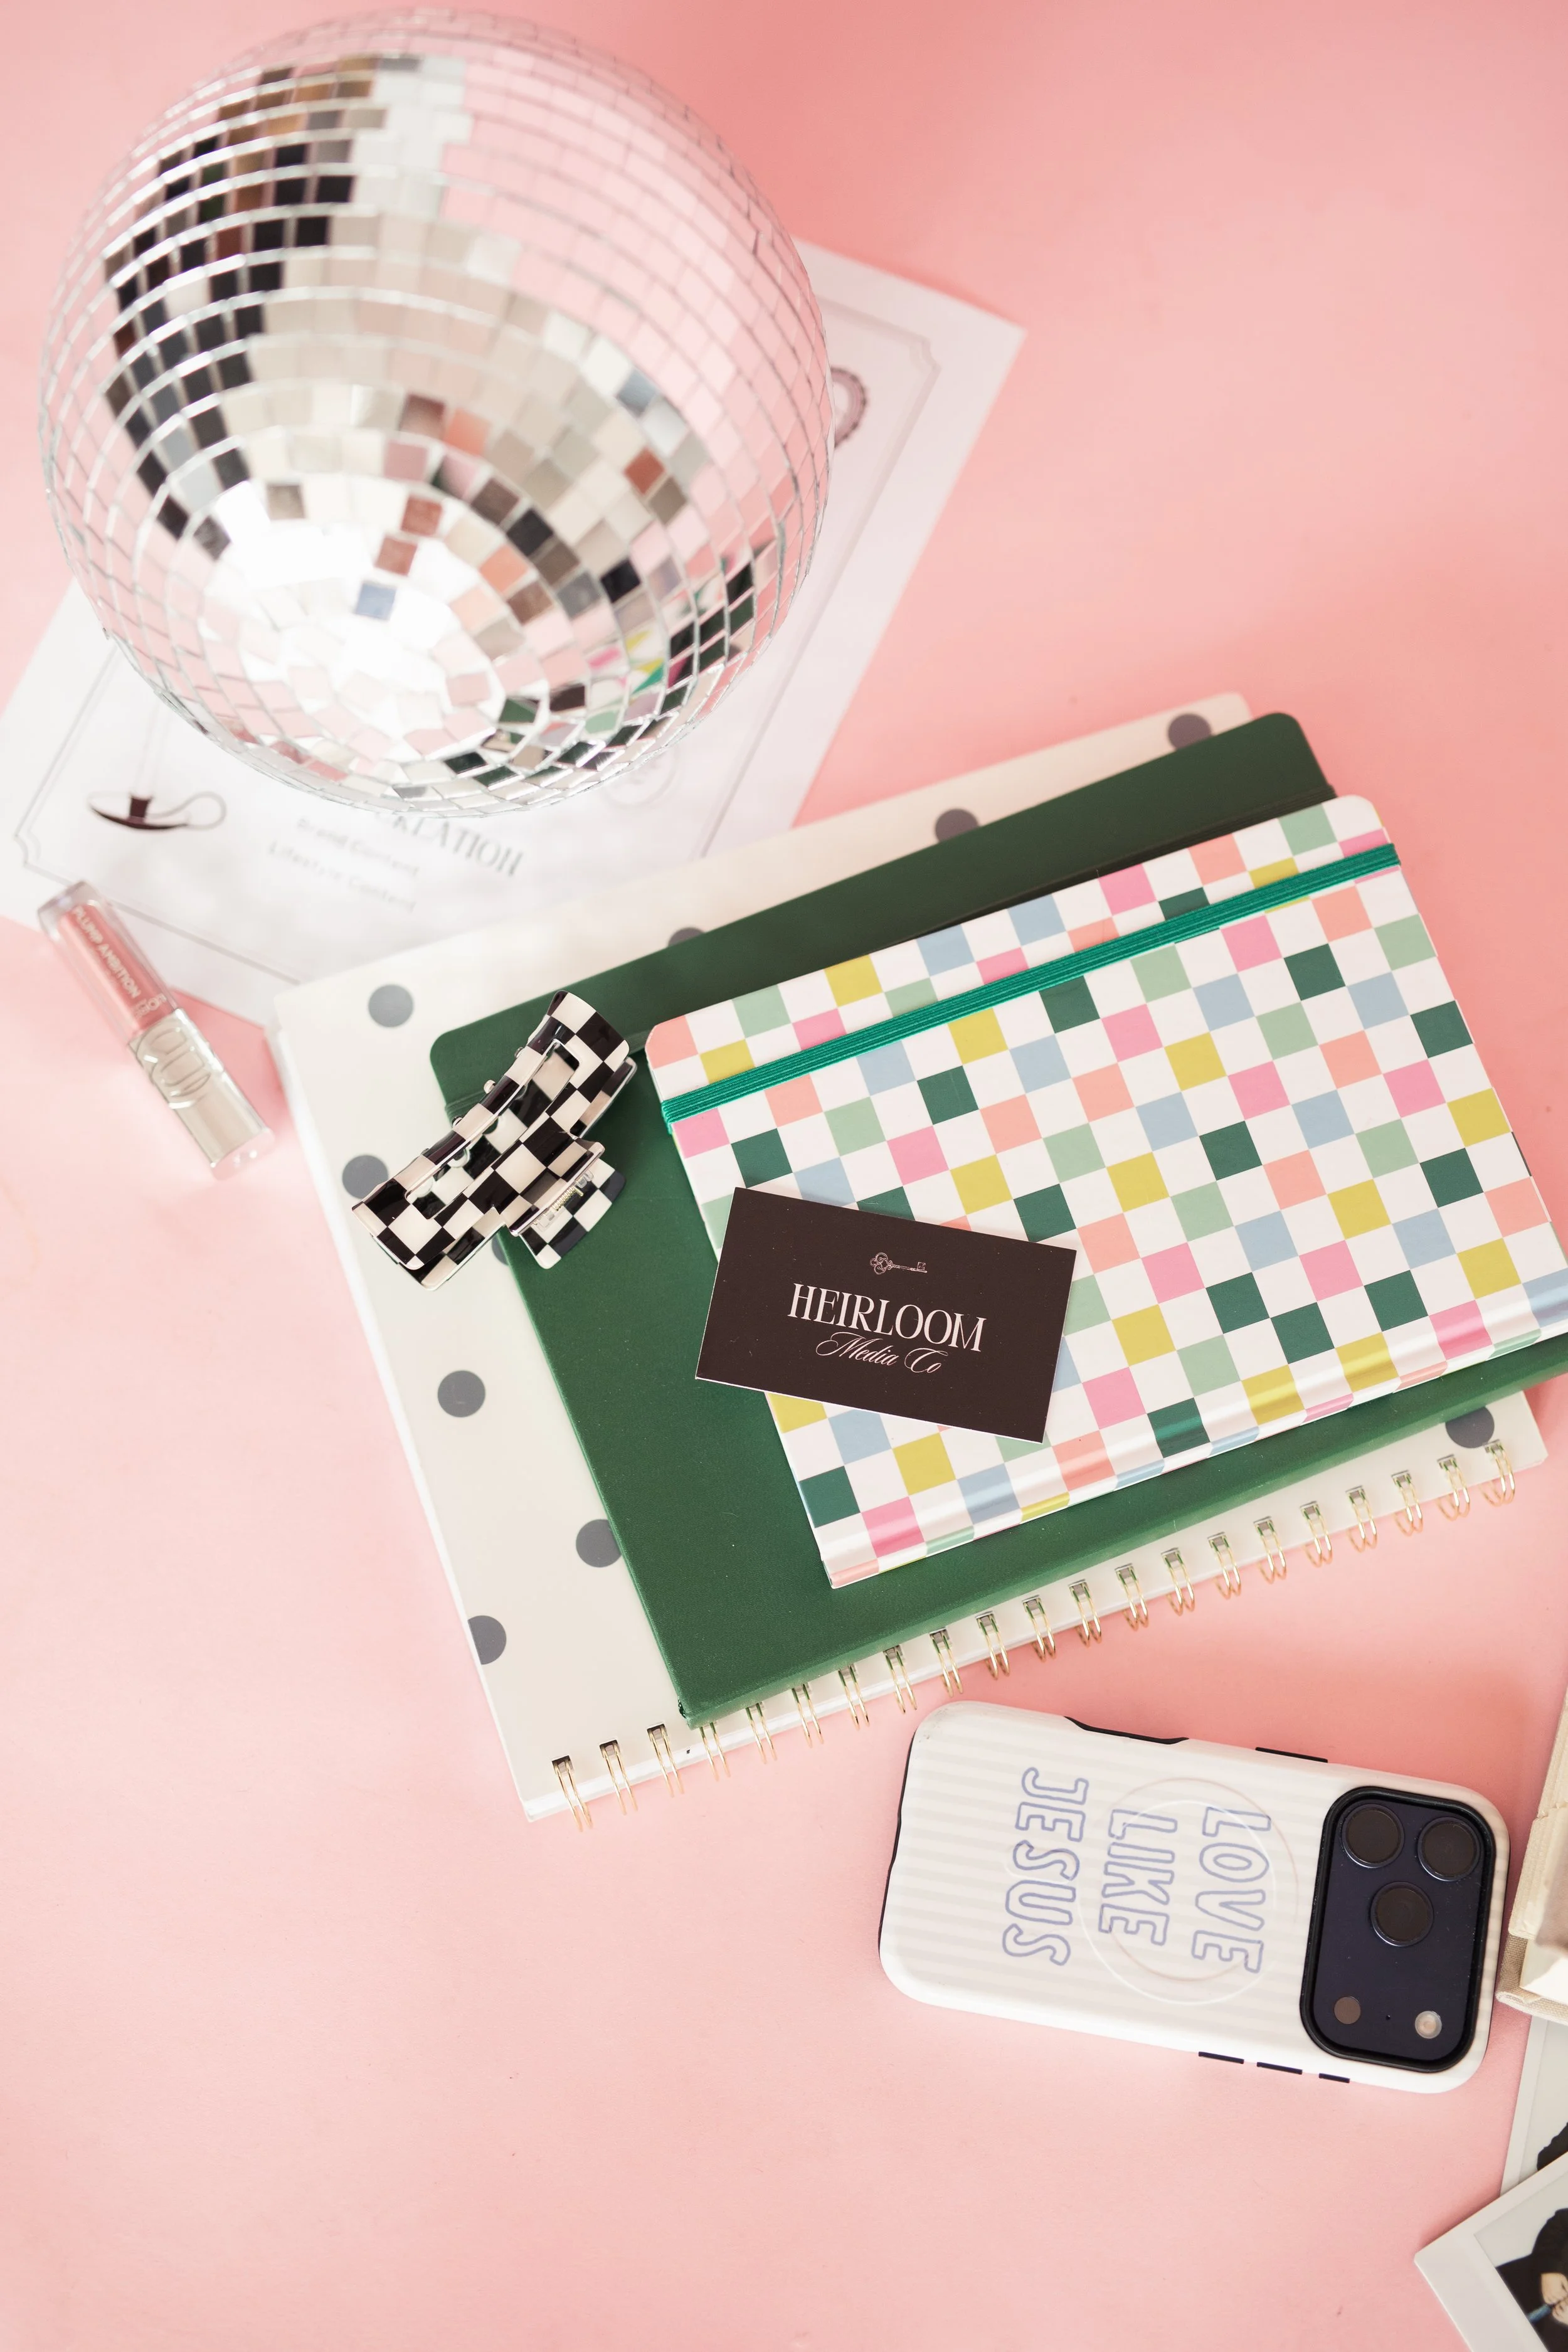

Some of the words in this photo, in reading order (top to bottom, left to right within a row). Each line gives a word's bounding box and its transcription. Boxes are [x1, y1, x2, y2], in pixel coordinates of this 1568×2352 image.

[72, 905, 103, 946] PLUMP
[97, 941, 142, 999] AMBITION
[787, 1283, 987, 1352] HEIRLOOM
[815, 1331, 900, 1366] Media
[904, 1347, 949, 1374] Co
[1002, 1766, 1089, 1966] JESUS
[1098, 1808, 1178, 1946] LIKE
[1191, 1806, 1272, 1974] LOVE
